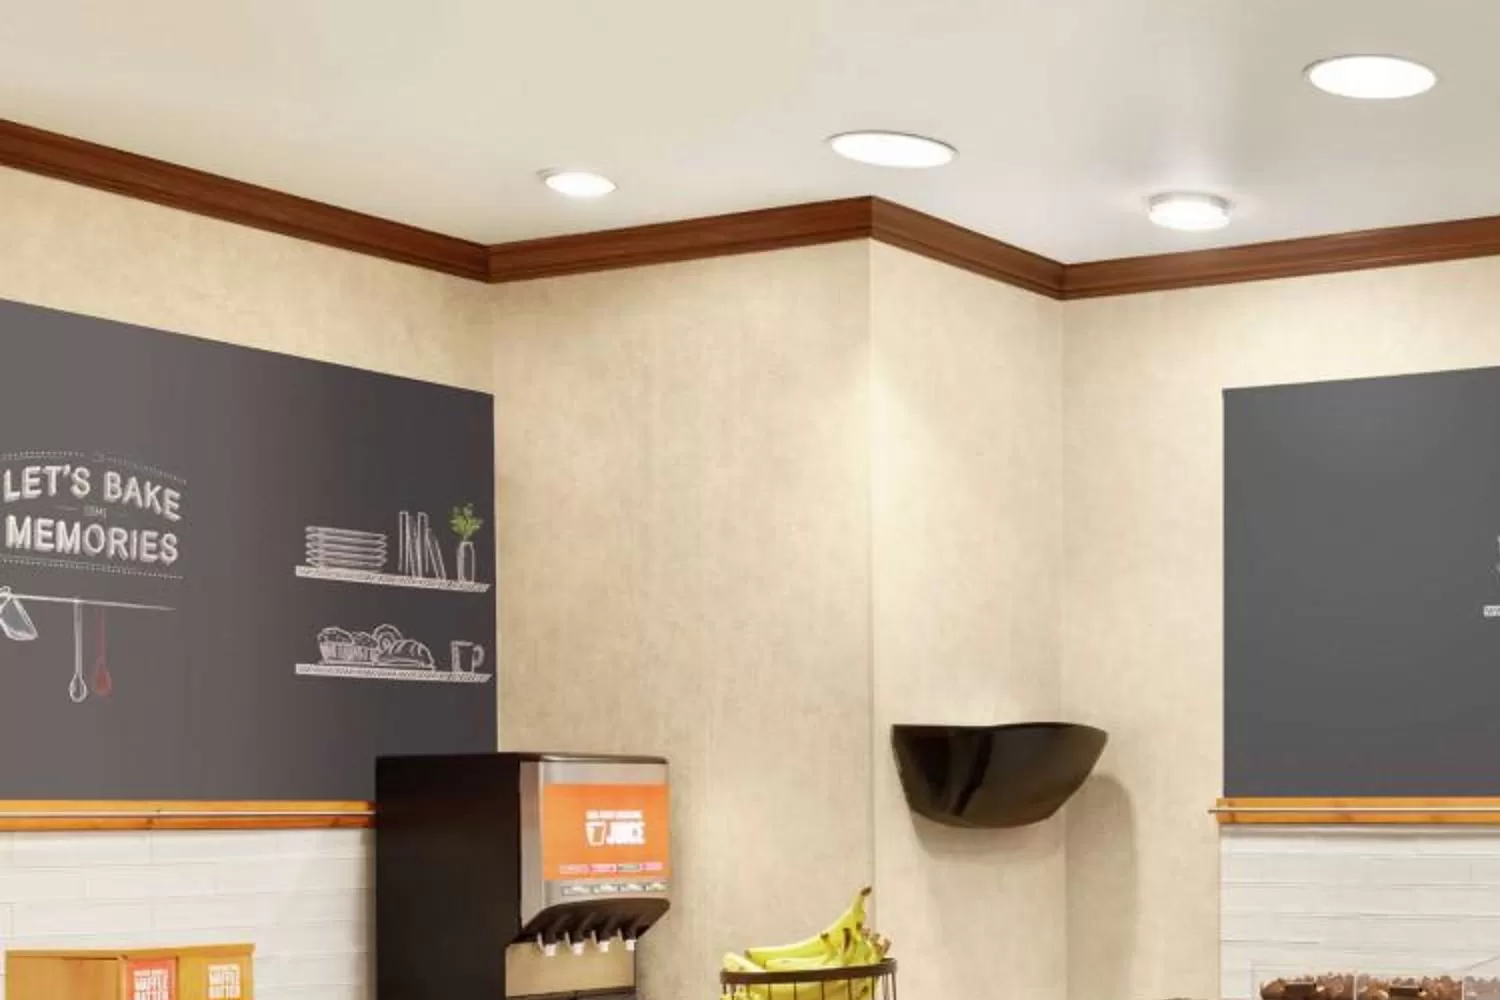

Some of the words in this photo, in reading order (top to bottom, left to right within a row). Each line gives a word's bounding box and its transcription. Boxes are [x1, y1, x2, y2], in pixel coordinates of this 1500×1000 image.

[3, 464, 91, 502] LET'S
[103, 471, 182, 521] BAKE
[5, 514, 178, 565] MEMORIES
